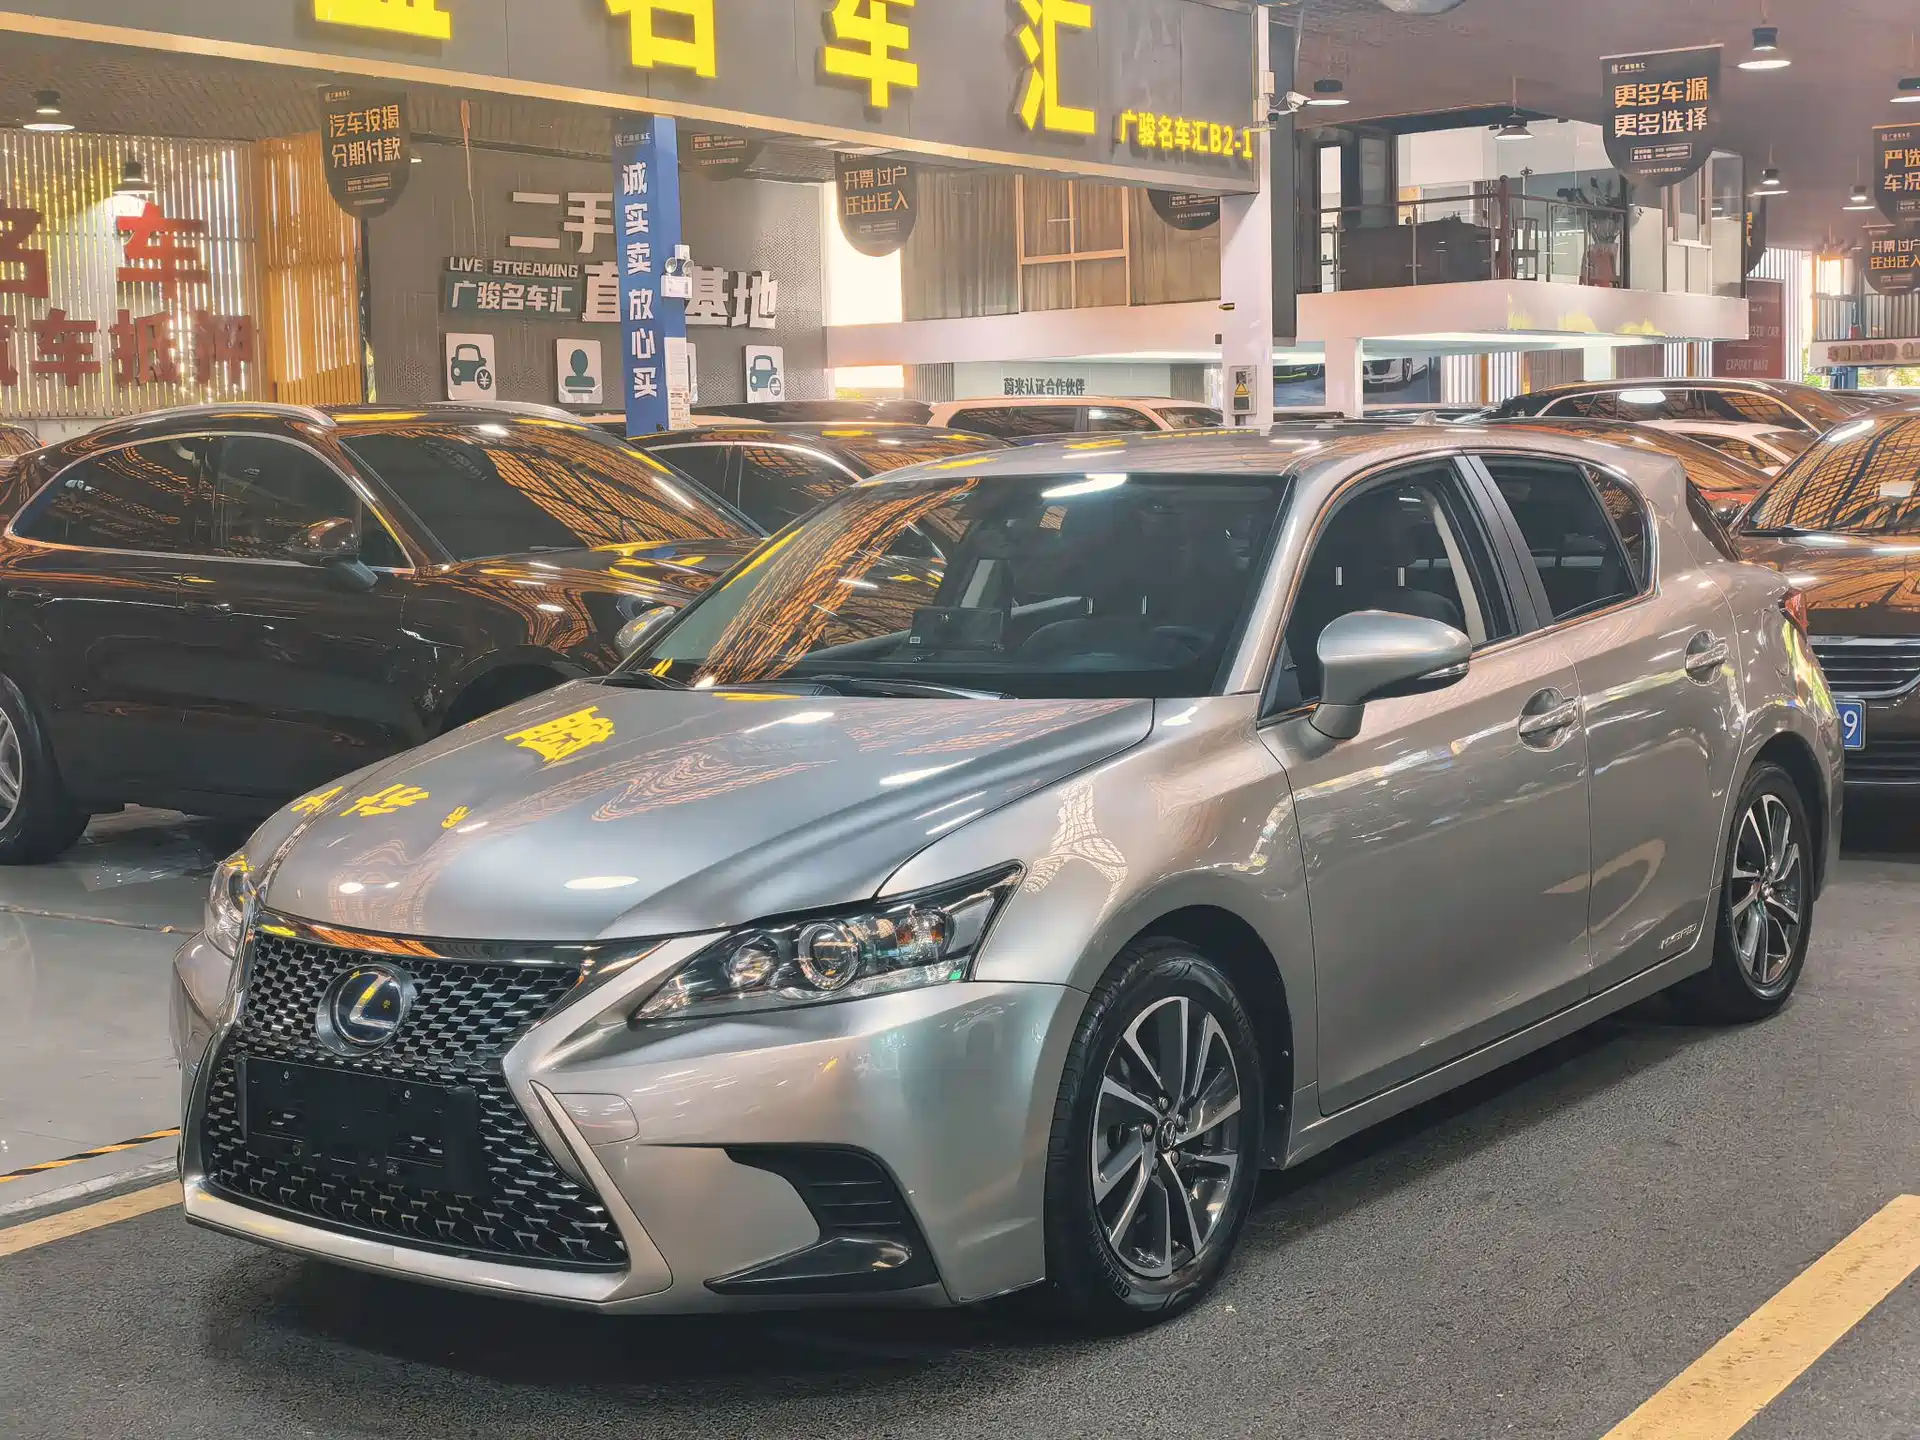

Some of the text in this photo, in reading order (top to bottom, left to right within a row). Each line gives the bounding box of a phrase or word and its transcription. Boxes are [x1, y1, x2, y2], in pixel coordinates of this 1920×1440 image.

[1614, 76, 1708, 108] 更多车源
[329, 104, 400, 138] 汽车按揭
[1120, 109, 1253, 158] 广骏名车汇B2-1
[1614, 106, 1708, 138] 更多选择
[331, 136, 401, 168] 分期付款
[844, 165, 907, 191] 开票过户
[449, 256, 579, 278] LIVE STREAMING
[451, 281, 573, 314] 广骏名车汇
[1003, 377, 1086, 396] 蔚来认证合作伙伴
